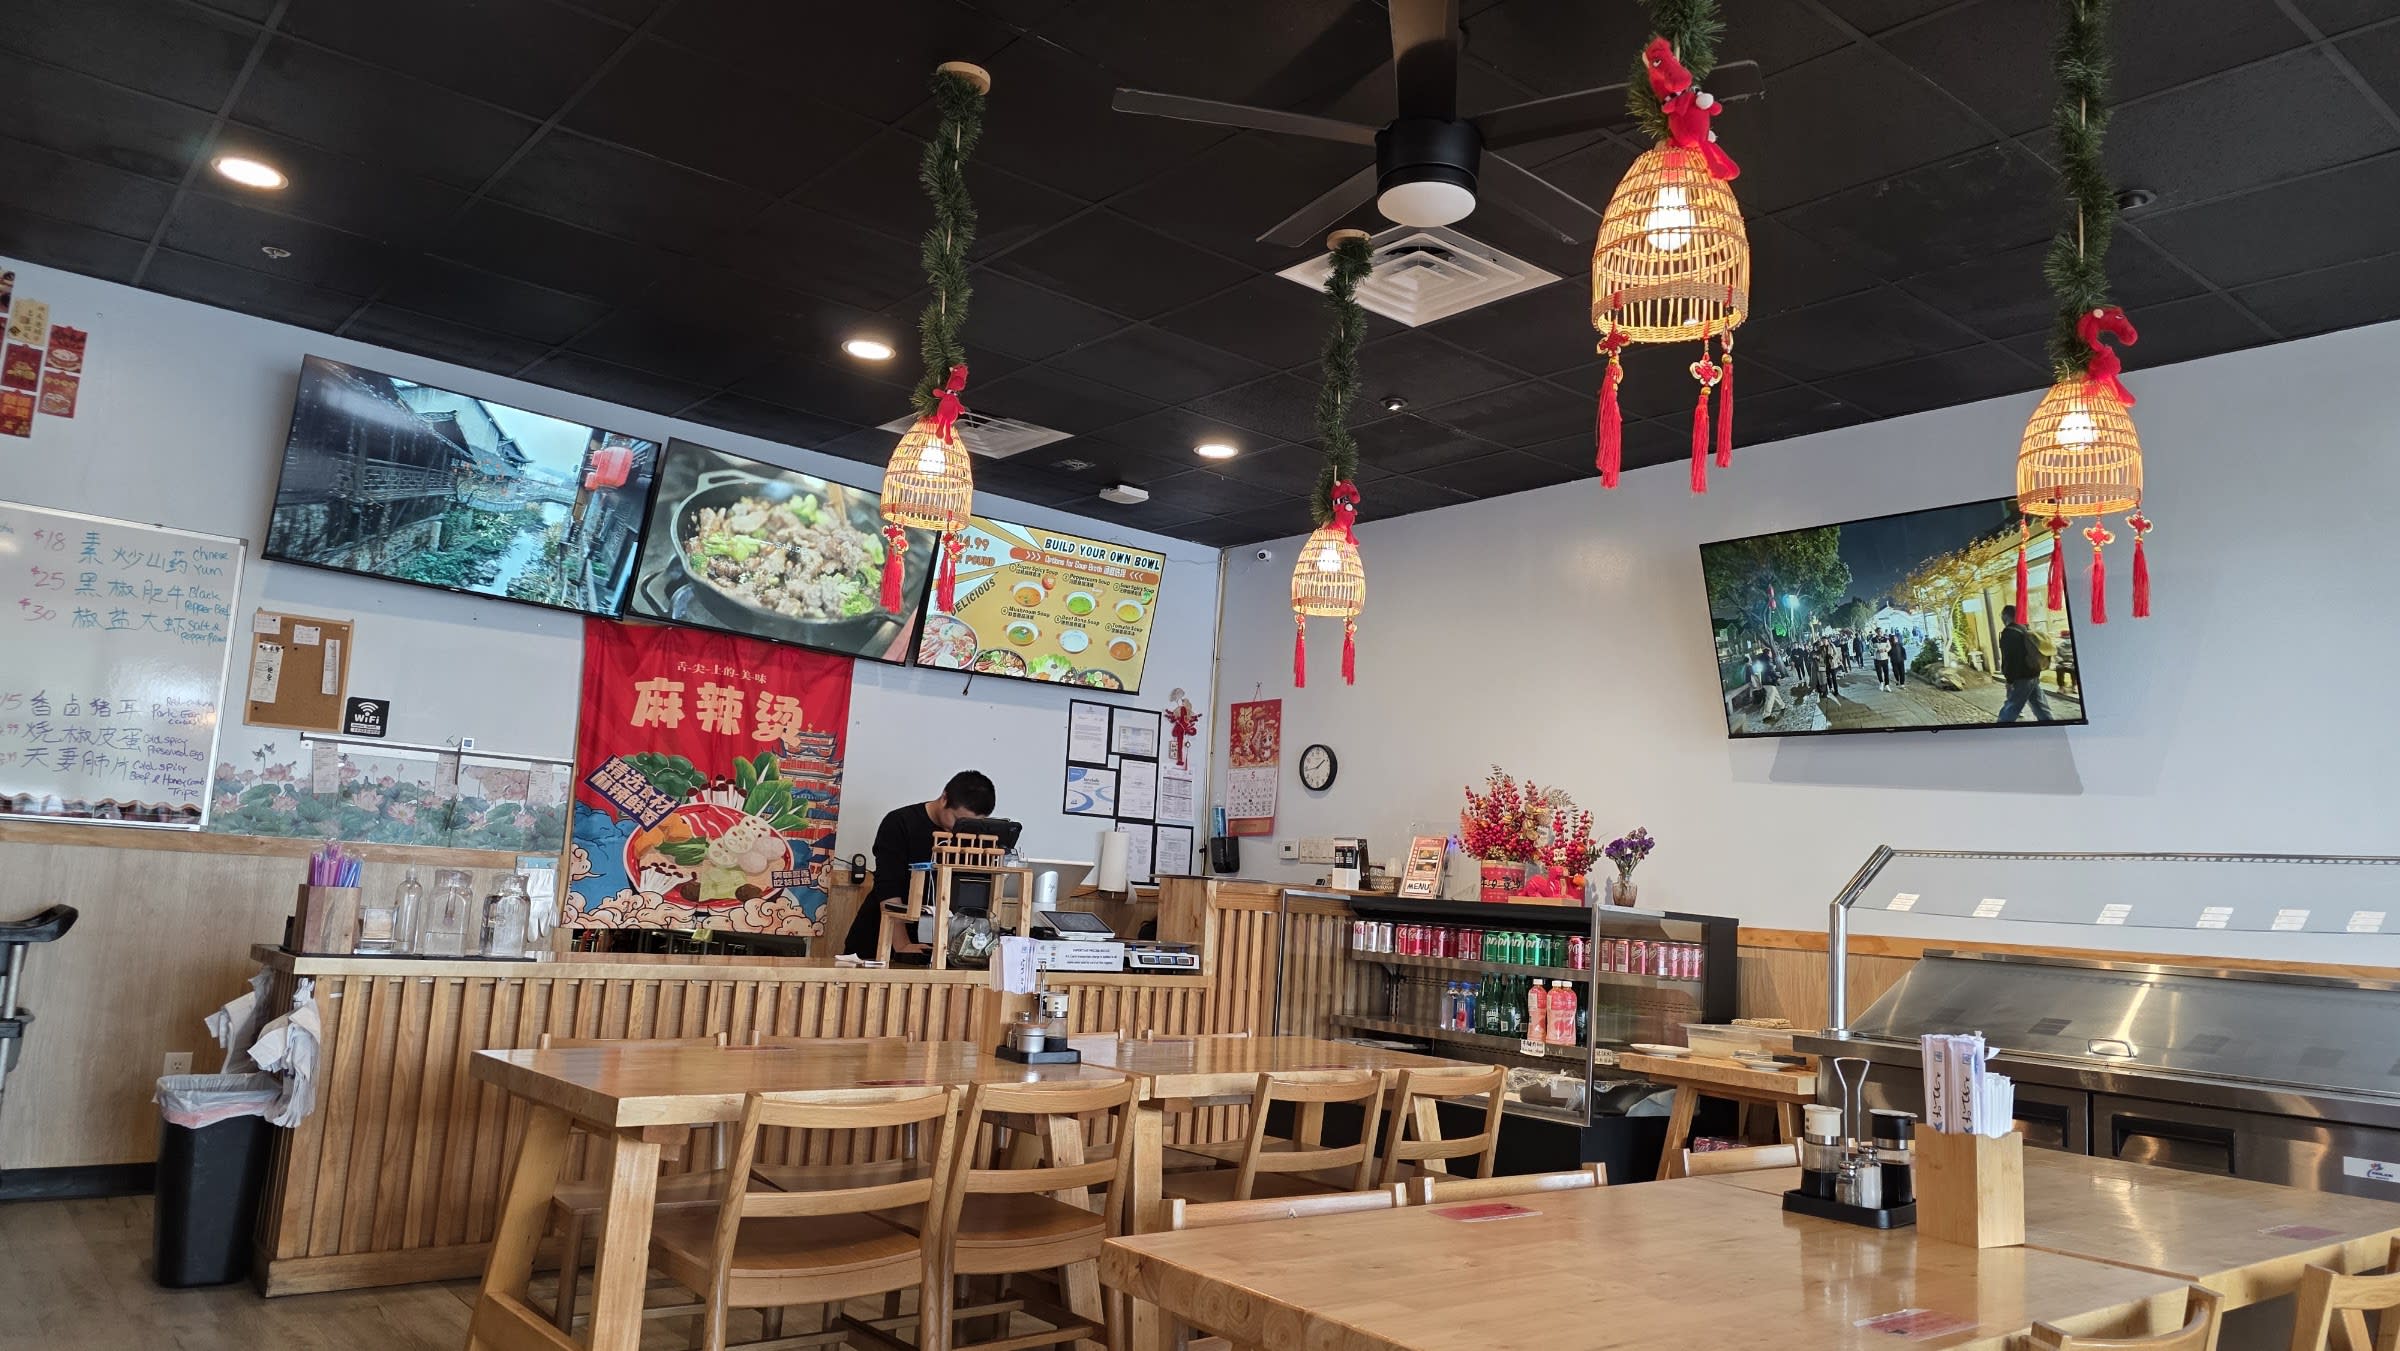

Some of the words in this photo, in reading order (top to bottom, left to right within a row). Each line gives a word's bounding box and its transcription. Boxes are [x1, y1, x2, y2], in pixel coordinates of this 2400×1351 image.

[966, 554, 996, 567] POUND
[1045, 538, 1076, 553] BUILD
[1079, 545, 1107, 559] YOUR
[1110, 551, 1131, 565] OWN
[1134, 556, 1160, 571] BOWL
[189, 586, 221, 600] Black
[951, 578, 997, 616] DELICIOUS
[354, 713, 381, 725] WiFi
[630, 676, 804, 748] 麻辣烫
[604, 757, 678, 815] 精选食材
[167, 787, 200, 801] Tripe
[1406, 882, 1431, 891] MENU
